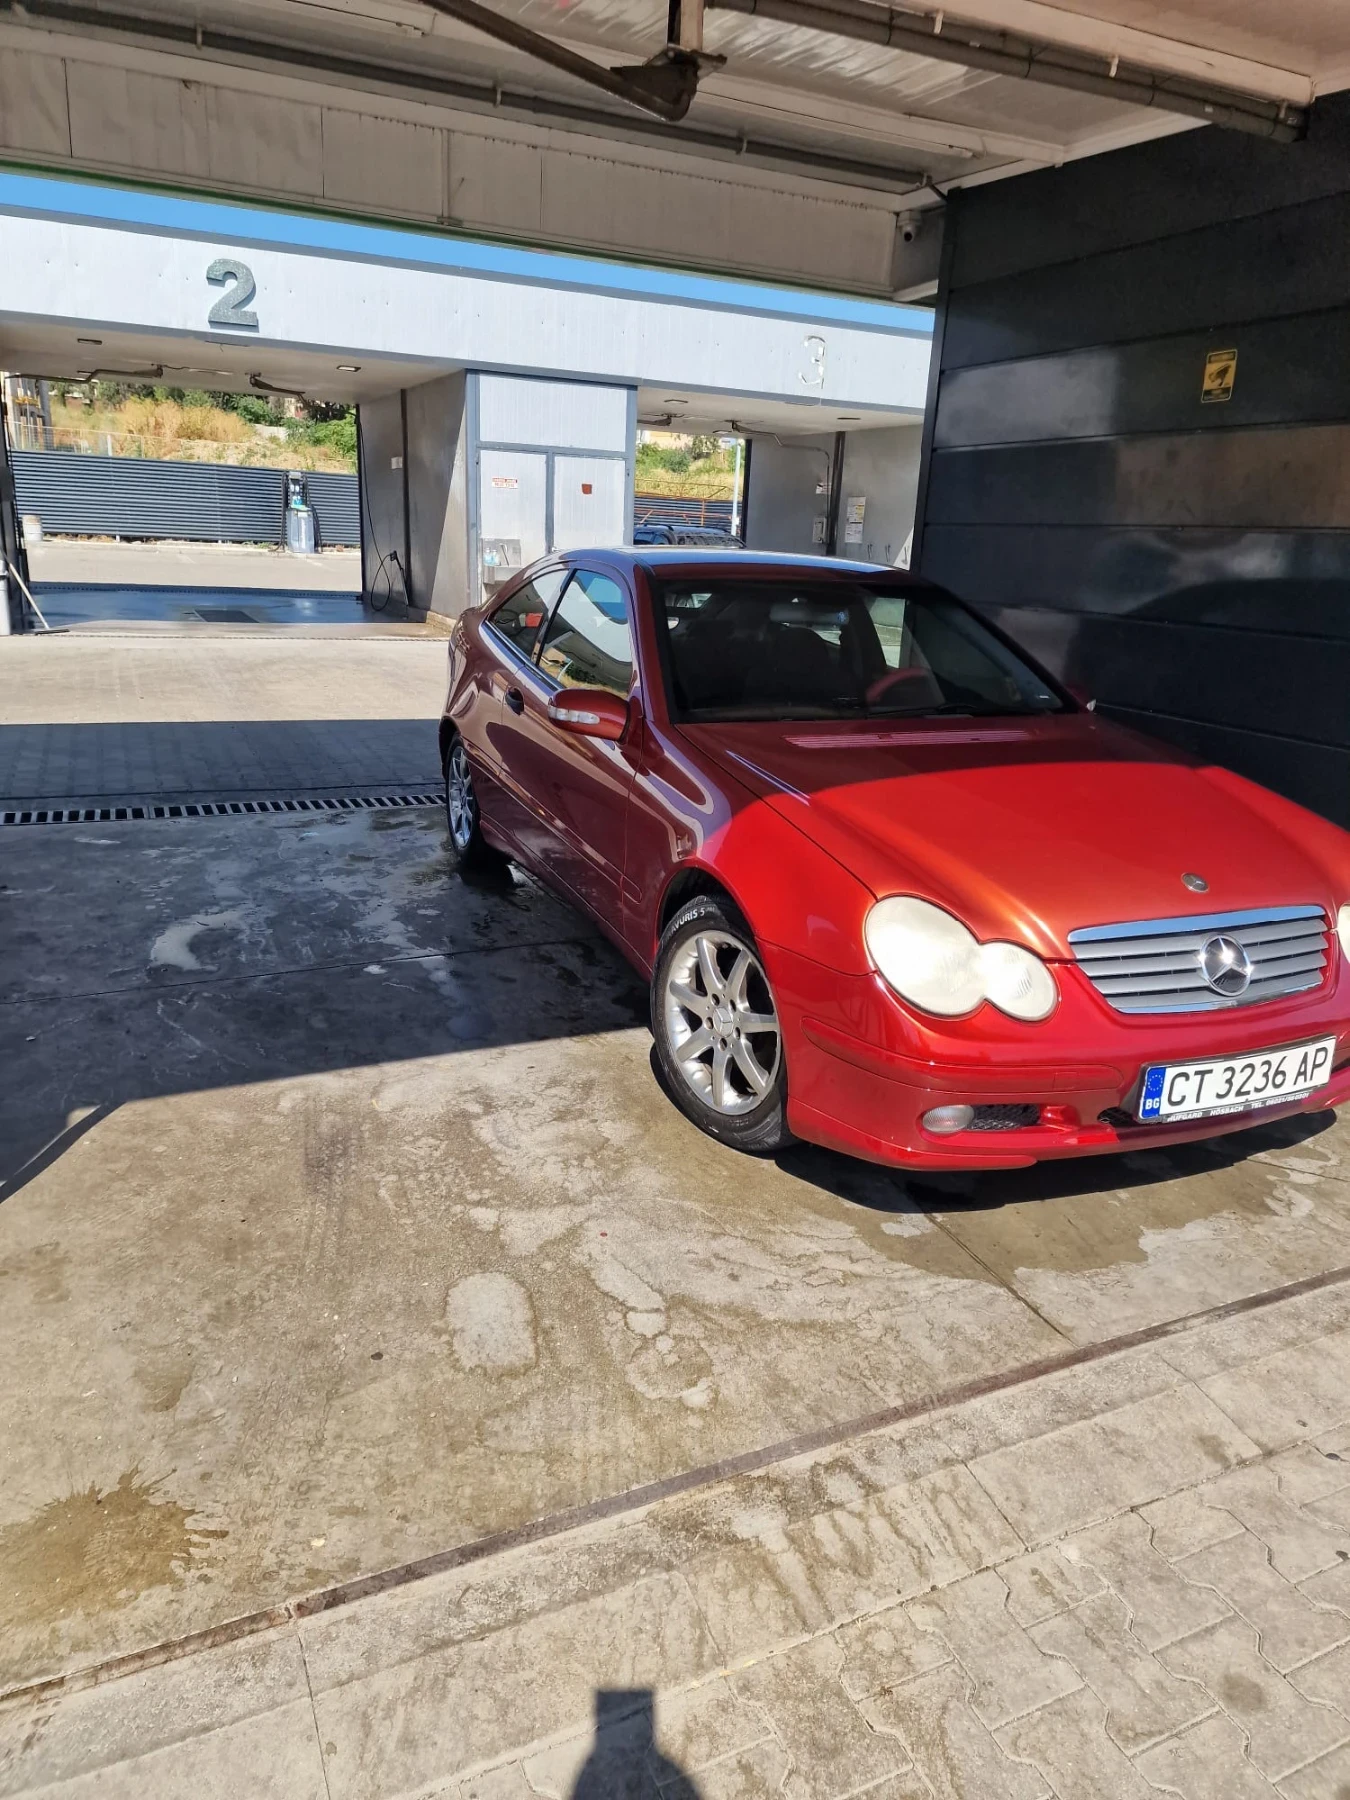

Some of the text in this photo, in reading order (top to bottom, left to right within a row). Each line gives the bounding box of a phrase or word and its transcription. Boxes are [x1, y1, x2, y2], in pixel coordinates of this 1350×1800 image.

[206, 258, 259, 333] 2
[799, 335, 826, 390] 3
[1145, 1097, 1160, 1110] BG
[1167, 1046, 1329, 1107] CT 3236 AP
